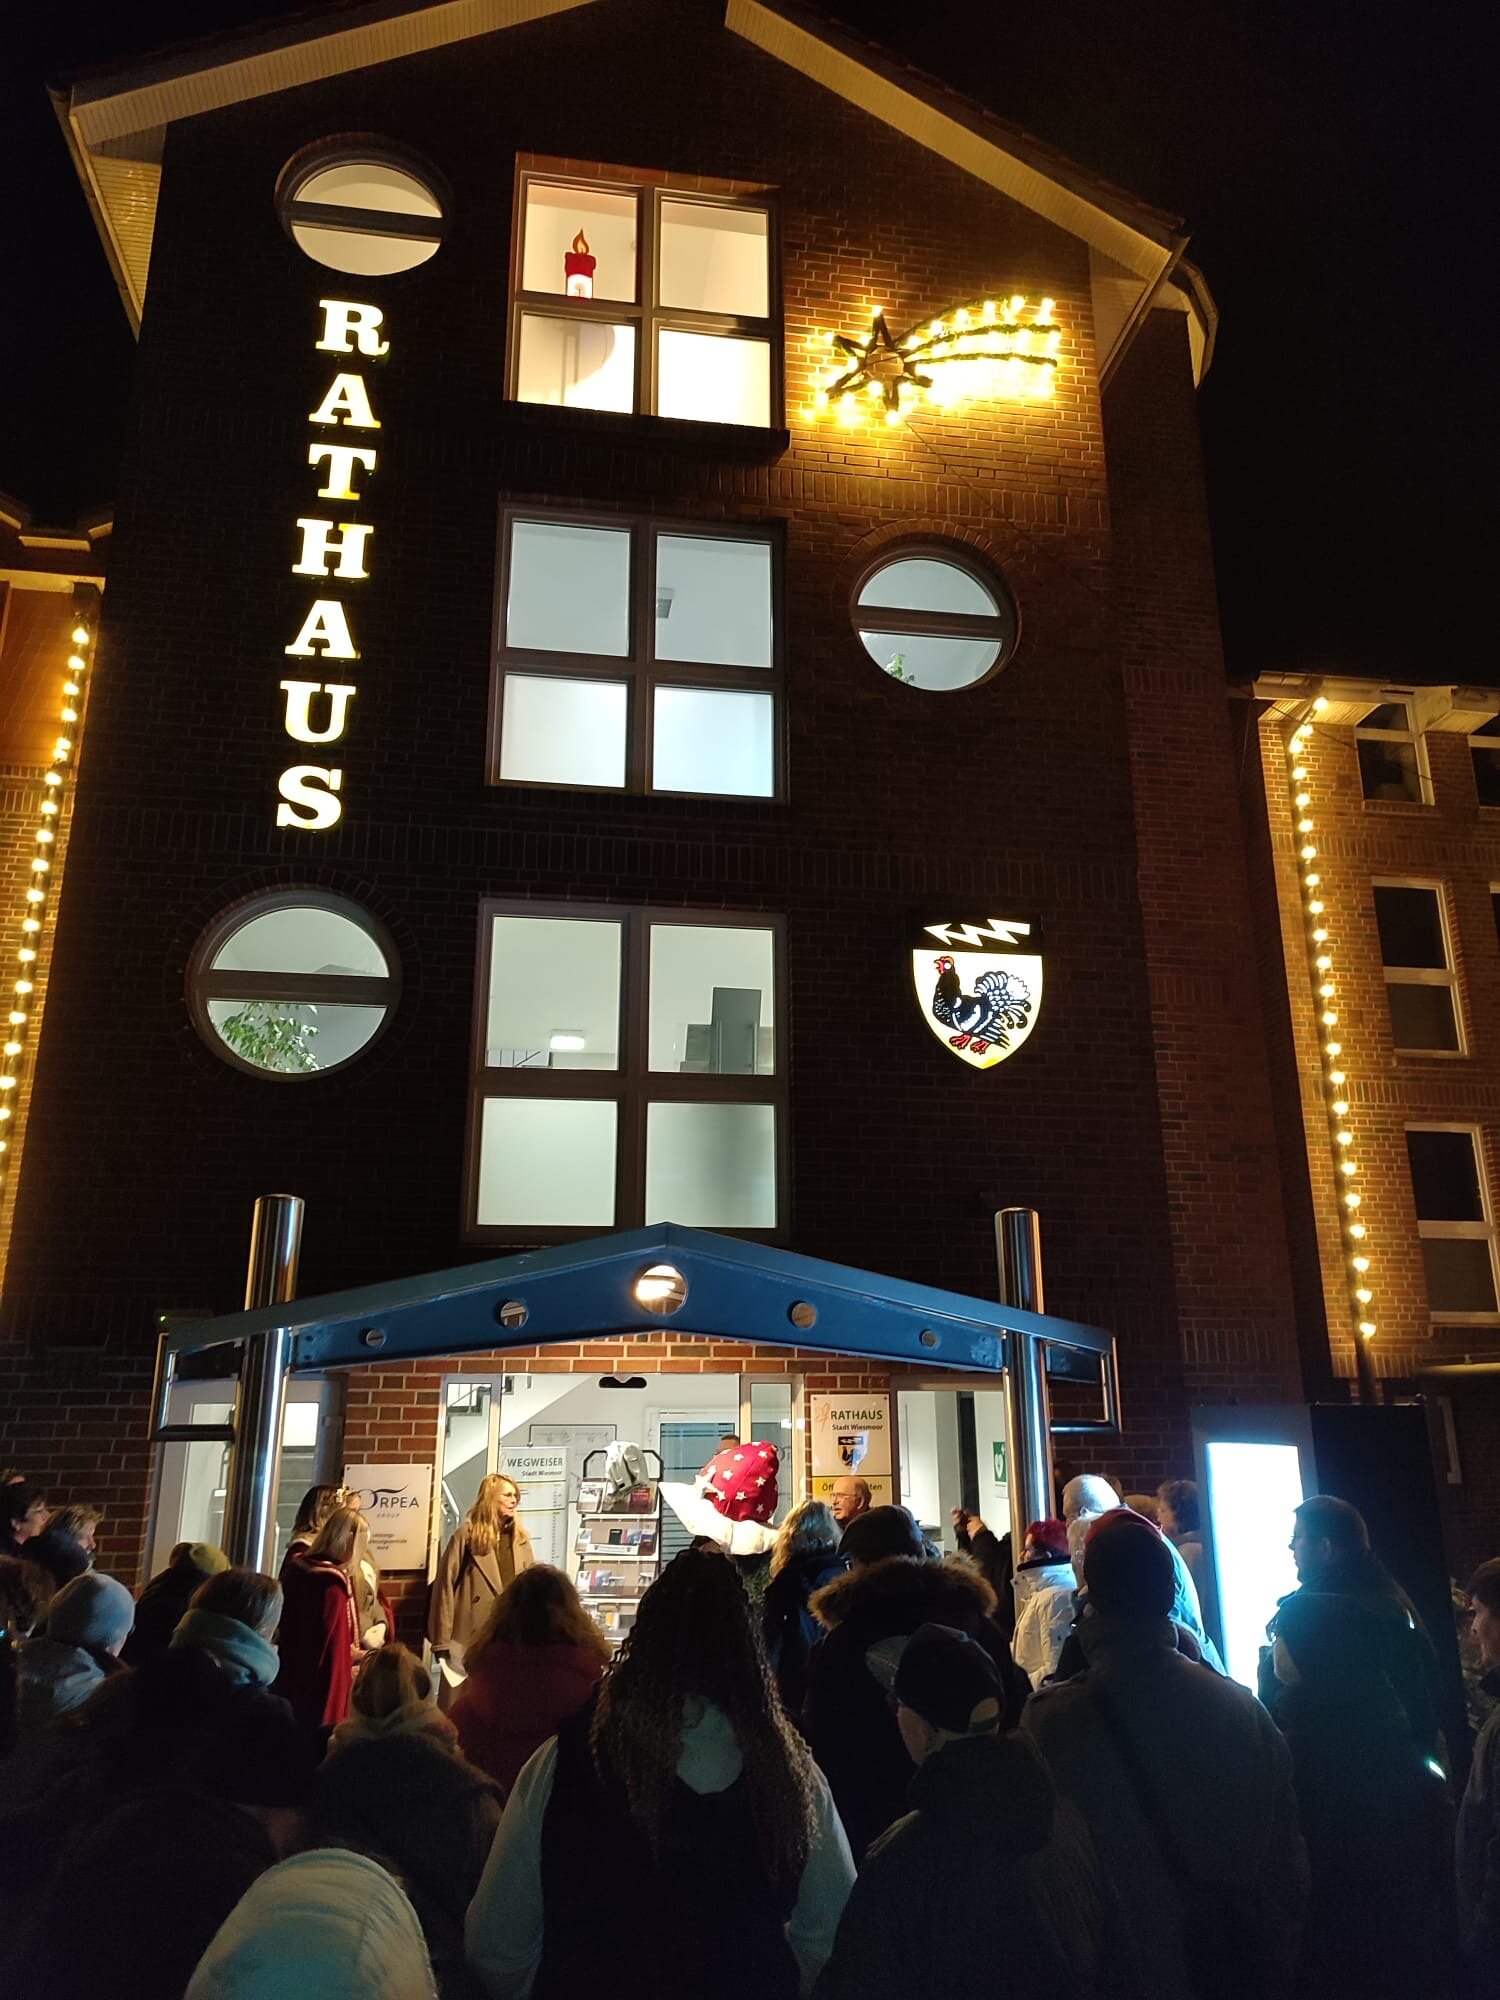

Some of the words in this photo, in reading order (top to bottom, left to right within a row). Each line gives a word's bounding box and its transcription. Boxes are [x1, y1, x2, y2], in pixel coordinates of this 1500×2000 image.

[276, 299, 390, 832] RATHAUS
[831, 1410, 883, 1420] RATHAUS
[507, 1457, 563, 1467] WEGWEISER
